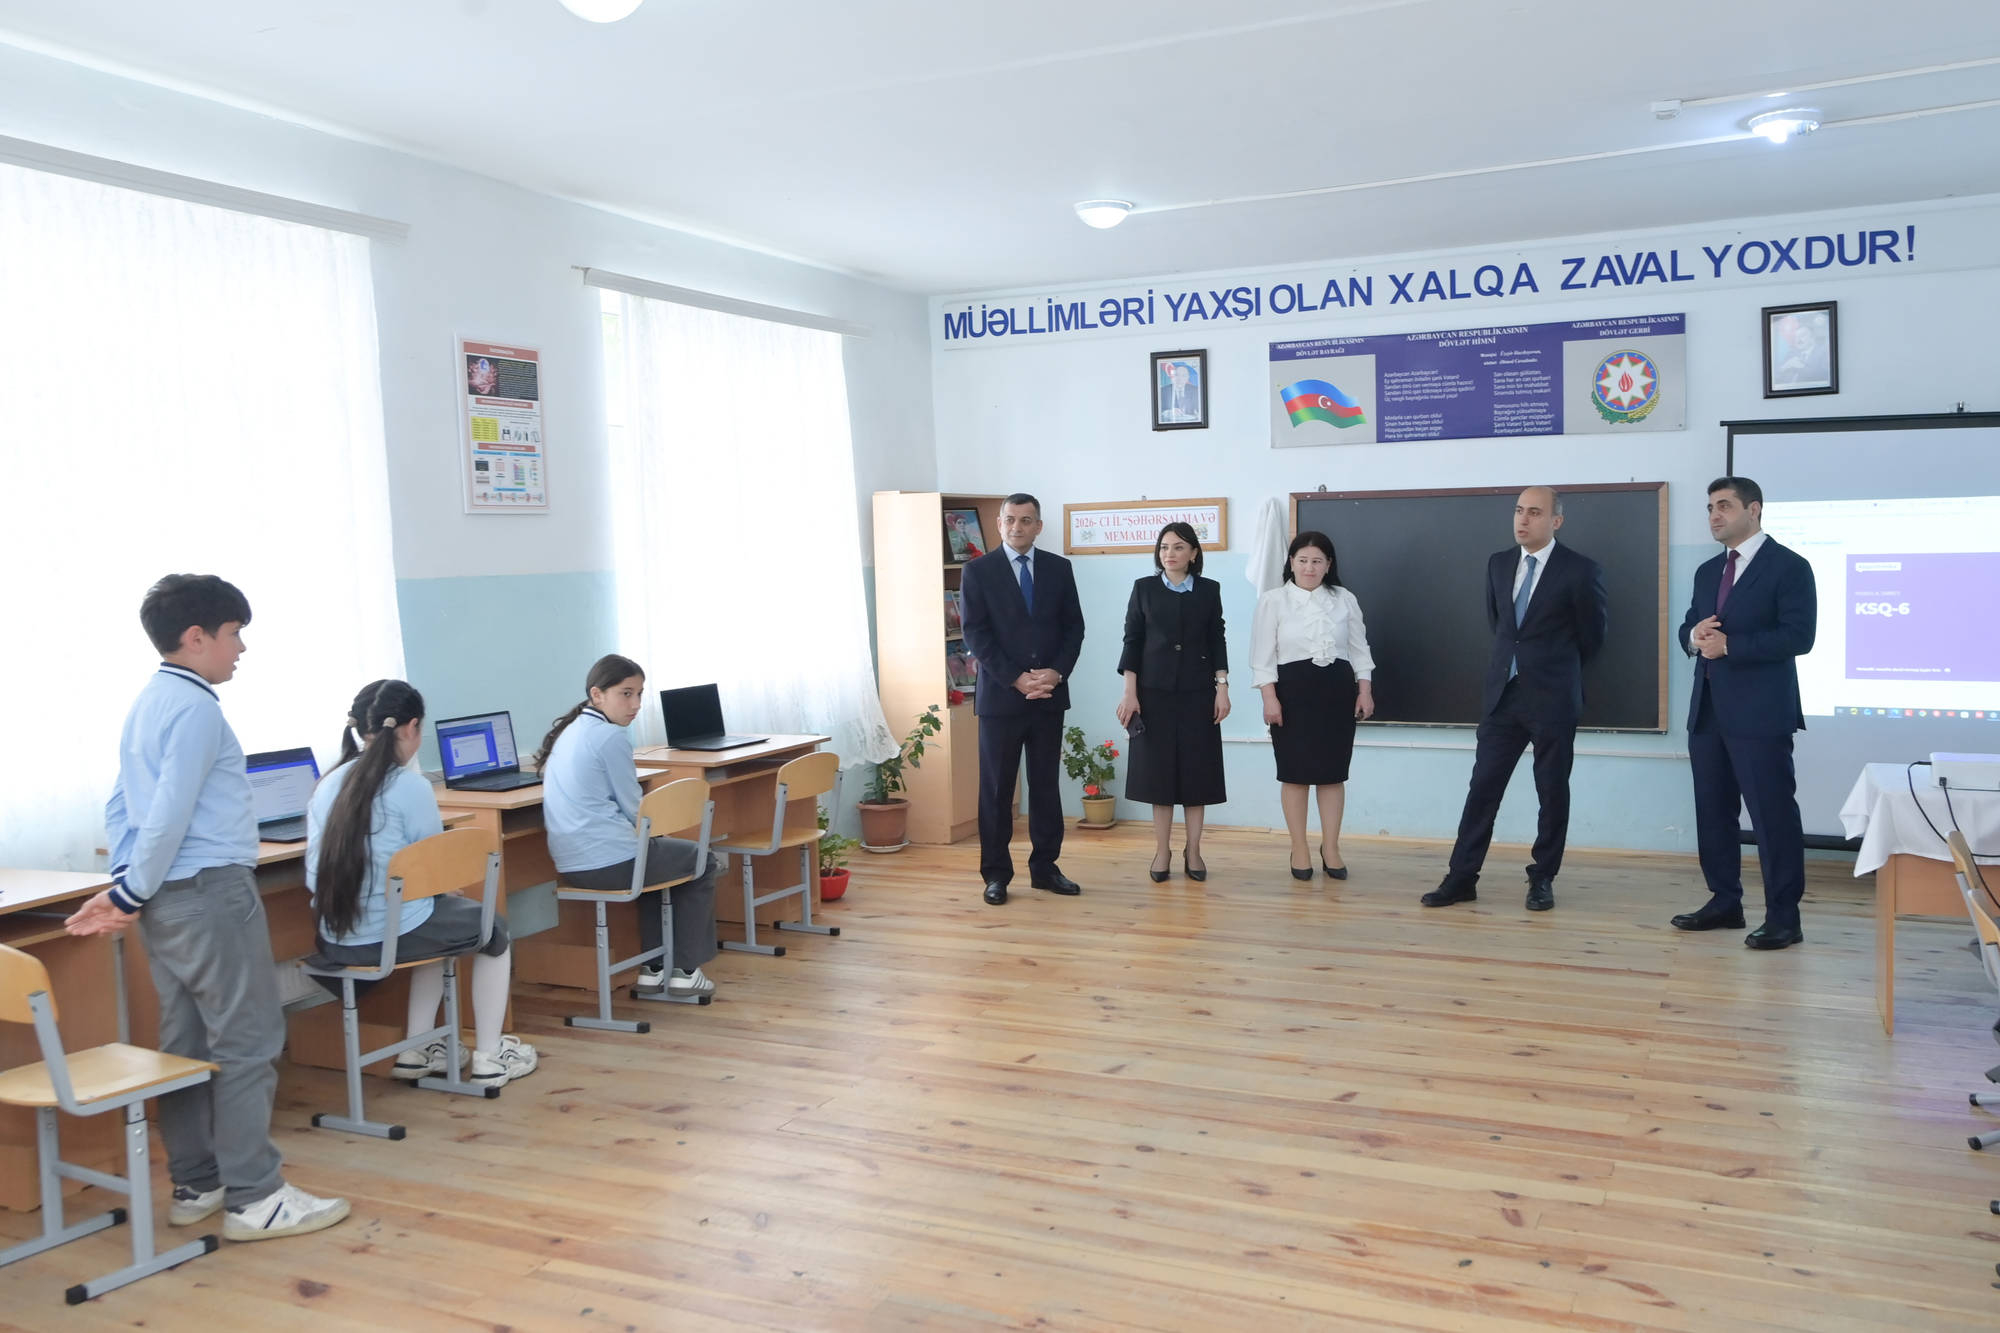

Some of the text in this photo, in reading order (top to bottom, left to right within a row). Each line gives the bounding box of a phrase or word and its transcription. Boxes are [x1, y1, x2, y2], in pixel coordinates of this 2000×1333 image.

[944, 225, 1916, 340] MÜƏLLİMLƏRİ YAXŞI OLAN XALQA ZAVAL YOXDUR!
[1200, 512, 1216, 524] VƏ
[1855, 602, 1910, 618] KSQ-6
